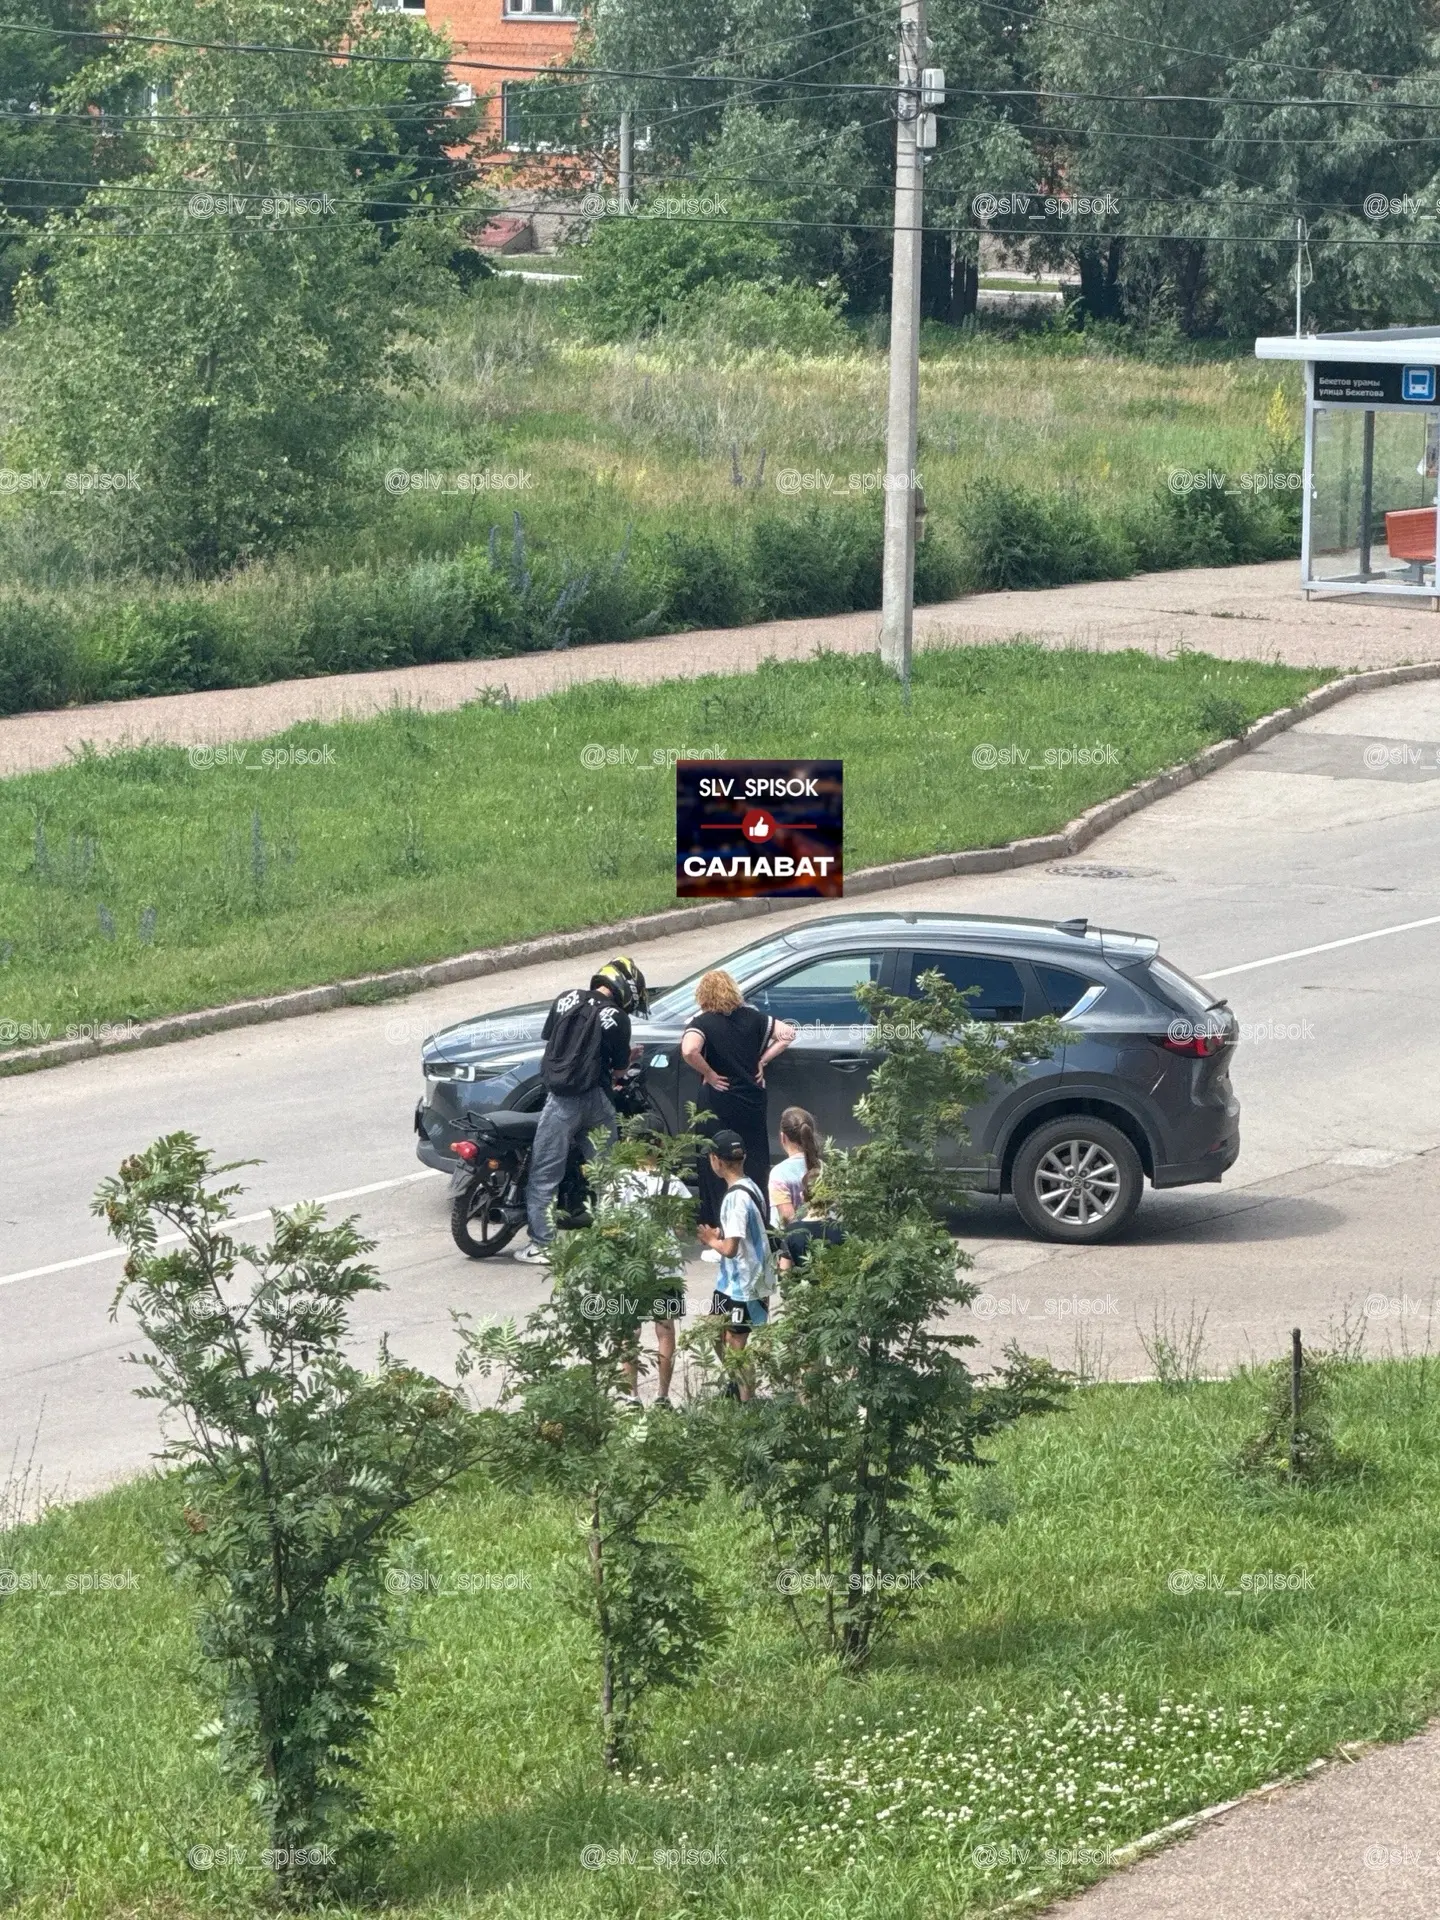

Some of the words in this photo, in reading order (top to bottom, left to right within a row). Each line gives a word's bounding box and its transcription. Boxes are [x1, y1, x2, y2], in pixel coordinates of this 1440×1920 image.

[1319, 377, 1351, 386] Бекетов
[1353, 379, 1380, 388] урамы
[1319, 388, 1343, 396] улица
[1345, 388, 1384, 397] Бекетова
